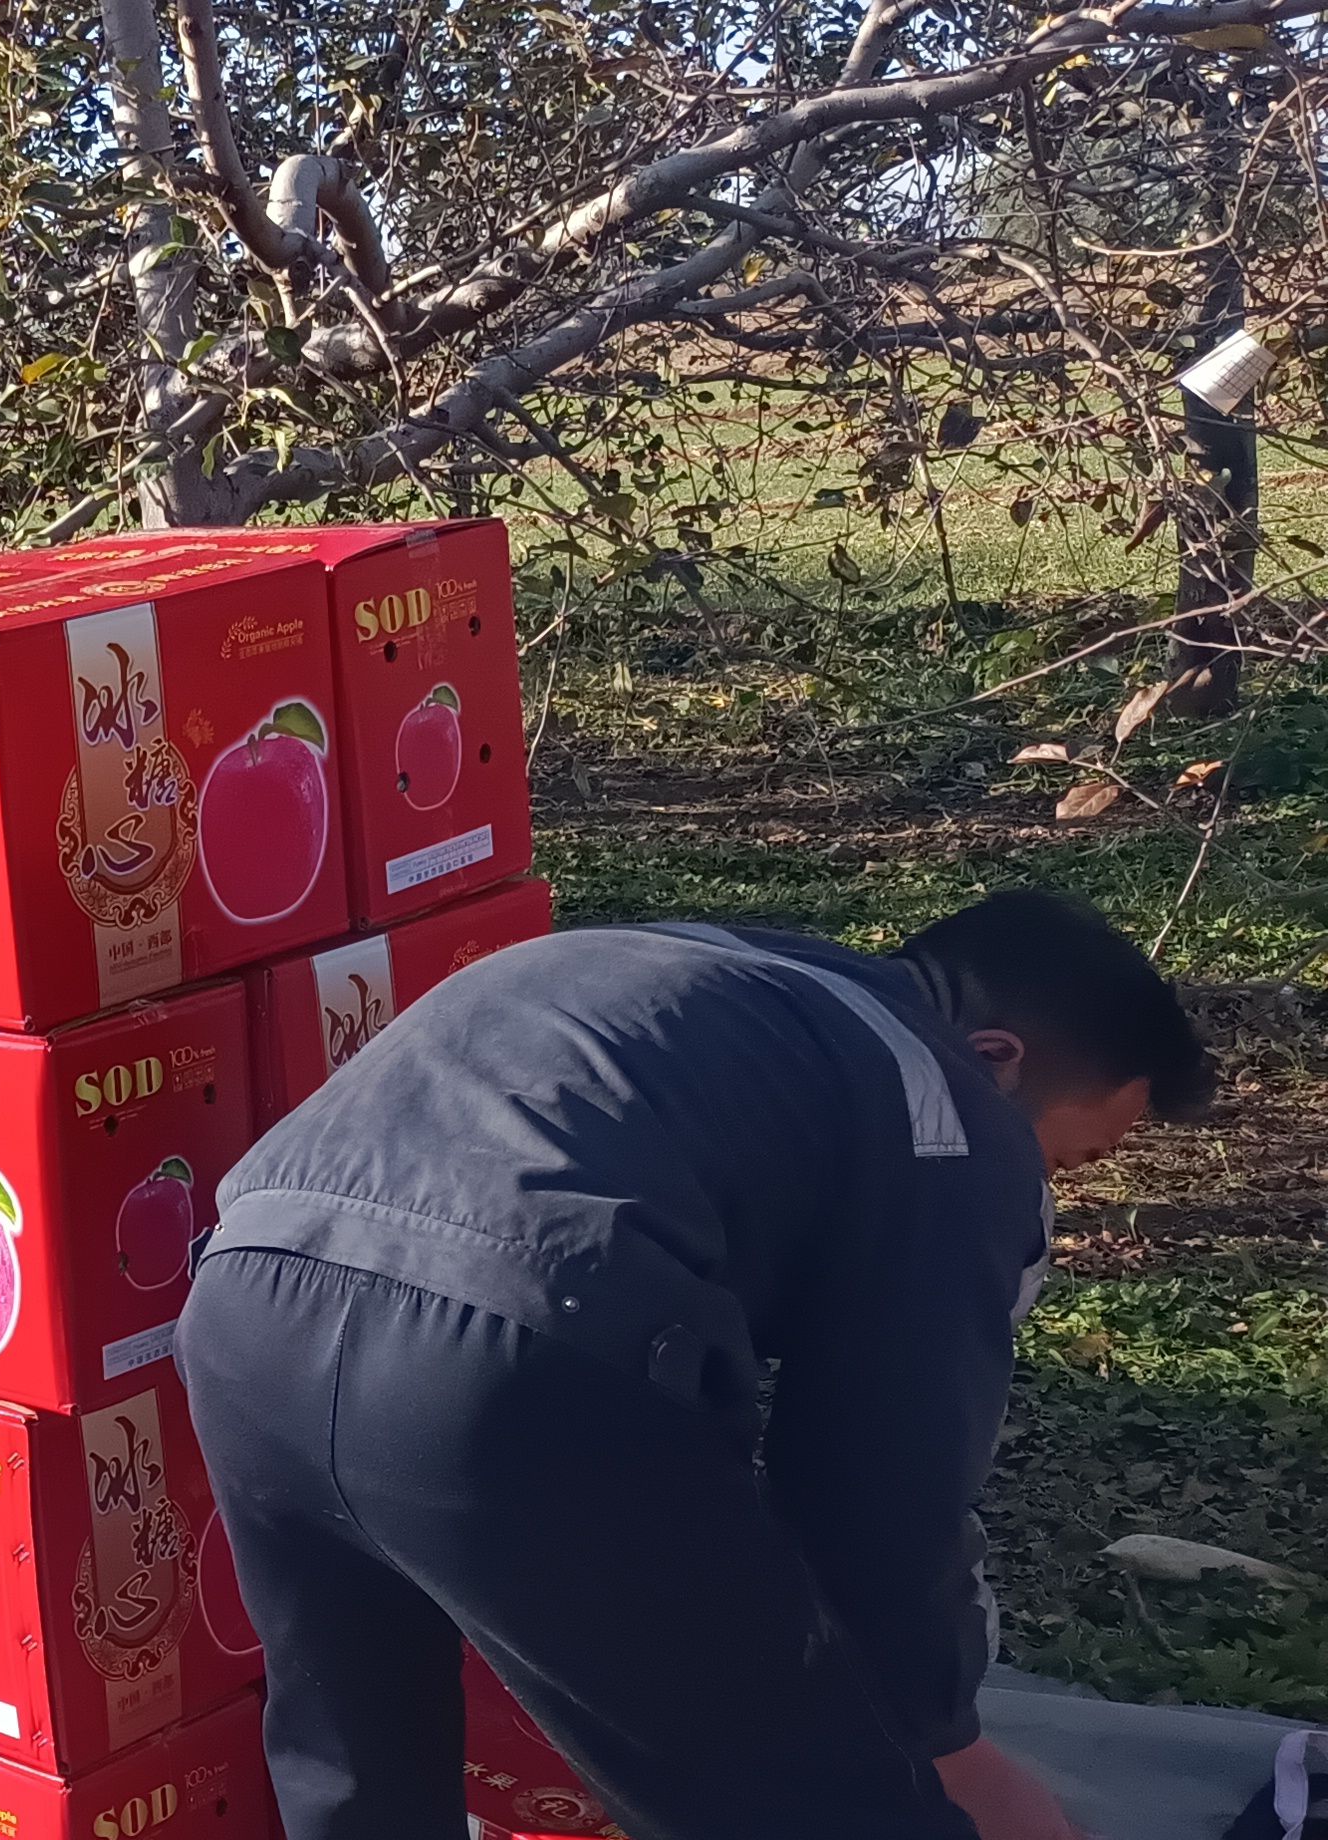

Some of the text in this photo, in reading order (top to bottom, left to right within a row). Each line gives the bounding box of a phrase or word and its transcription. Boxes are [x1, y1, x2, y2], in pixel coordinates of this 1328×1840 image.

[238, 618, 303, 643] Organic Apple
[355, 587, 431, 643] SOD
[75, 1056, 163, 1118] SOD
[463, 1760, 519, 1791] 水果
[94, 1783, 178, 1840] SOD
